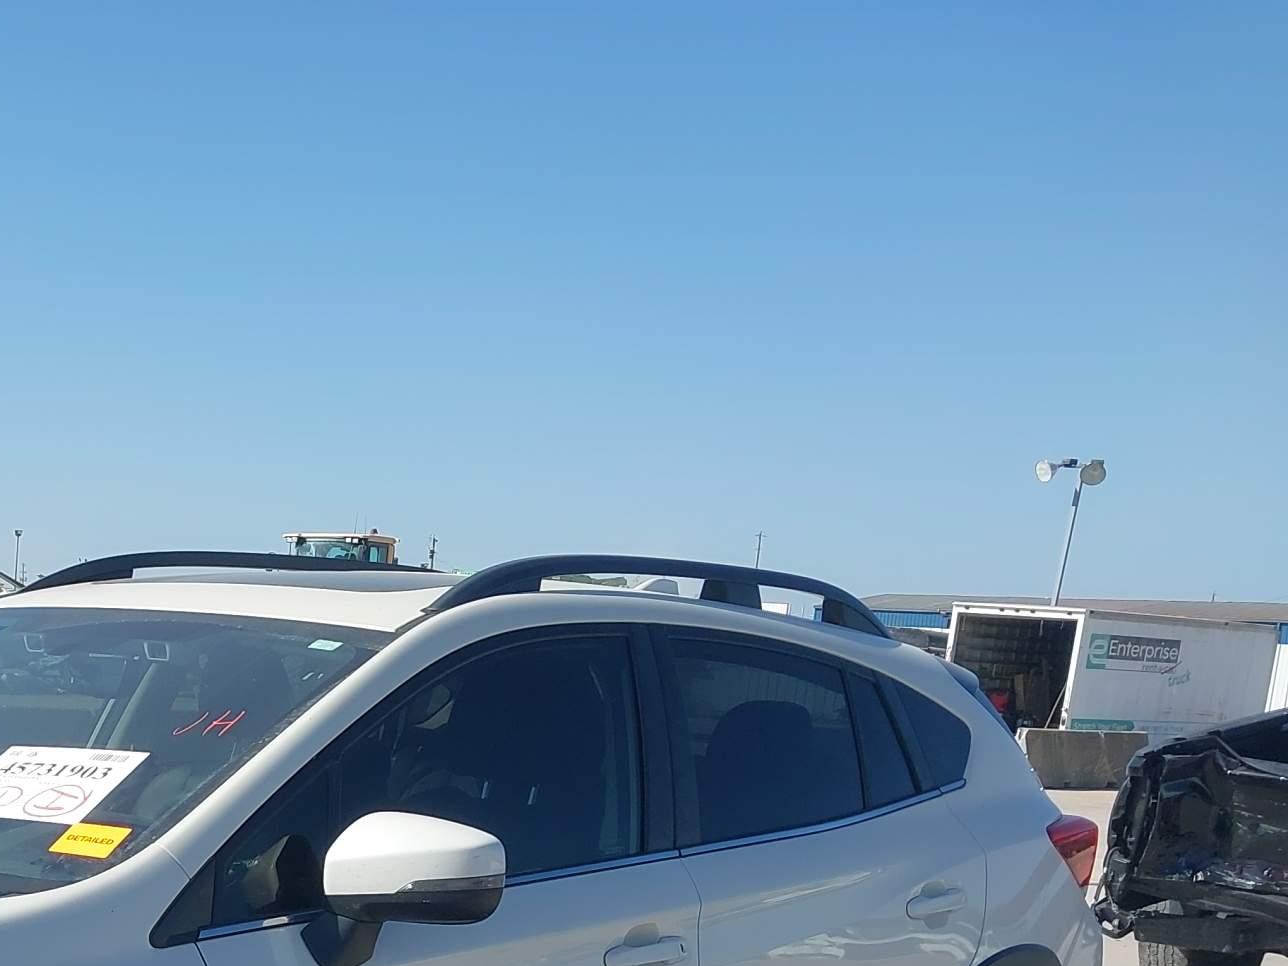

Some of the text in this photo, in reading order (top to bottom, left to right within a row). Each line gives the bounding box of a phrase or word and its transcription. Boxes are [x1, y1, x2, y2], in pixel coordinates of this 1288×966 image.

[1108, 640, 1179, 662] Enterprise
[0, 761, 113, 780] 45731903
[65, 834, 114, 846] DETAILED
